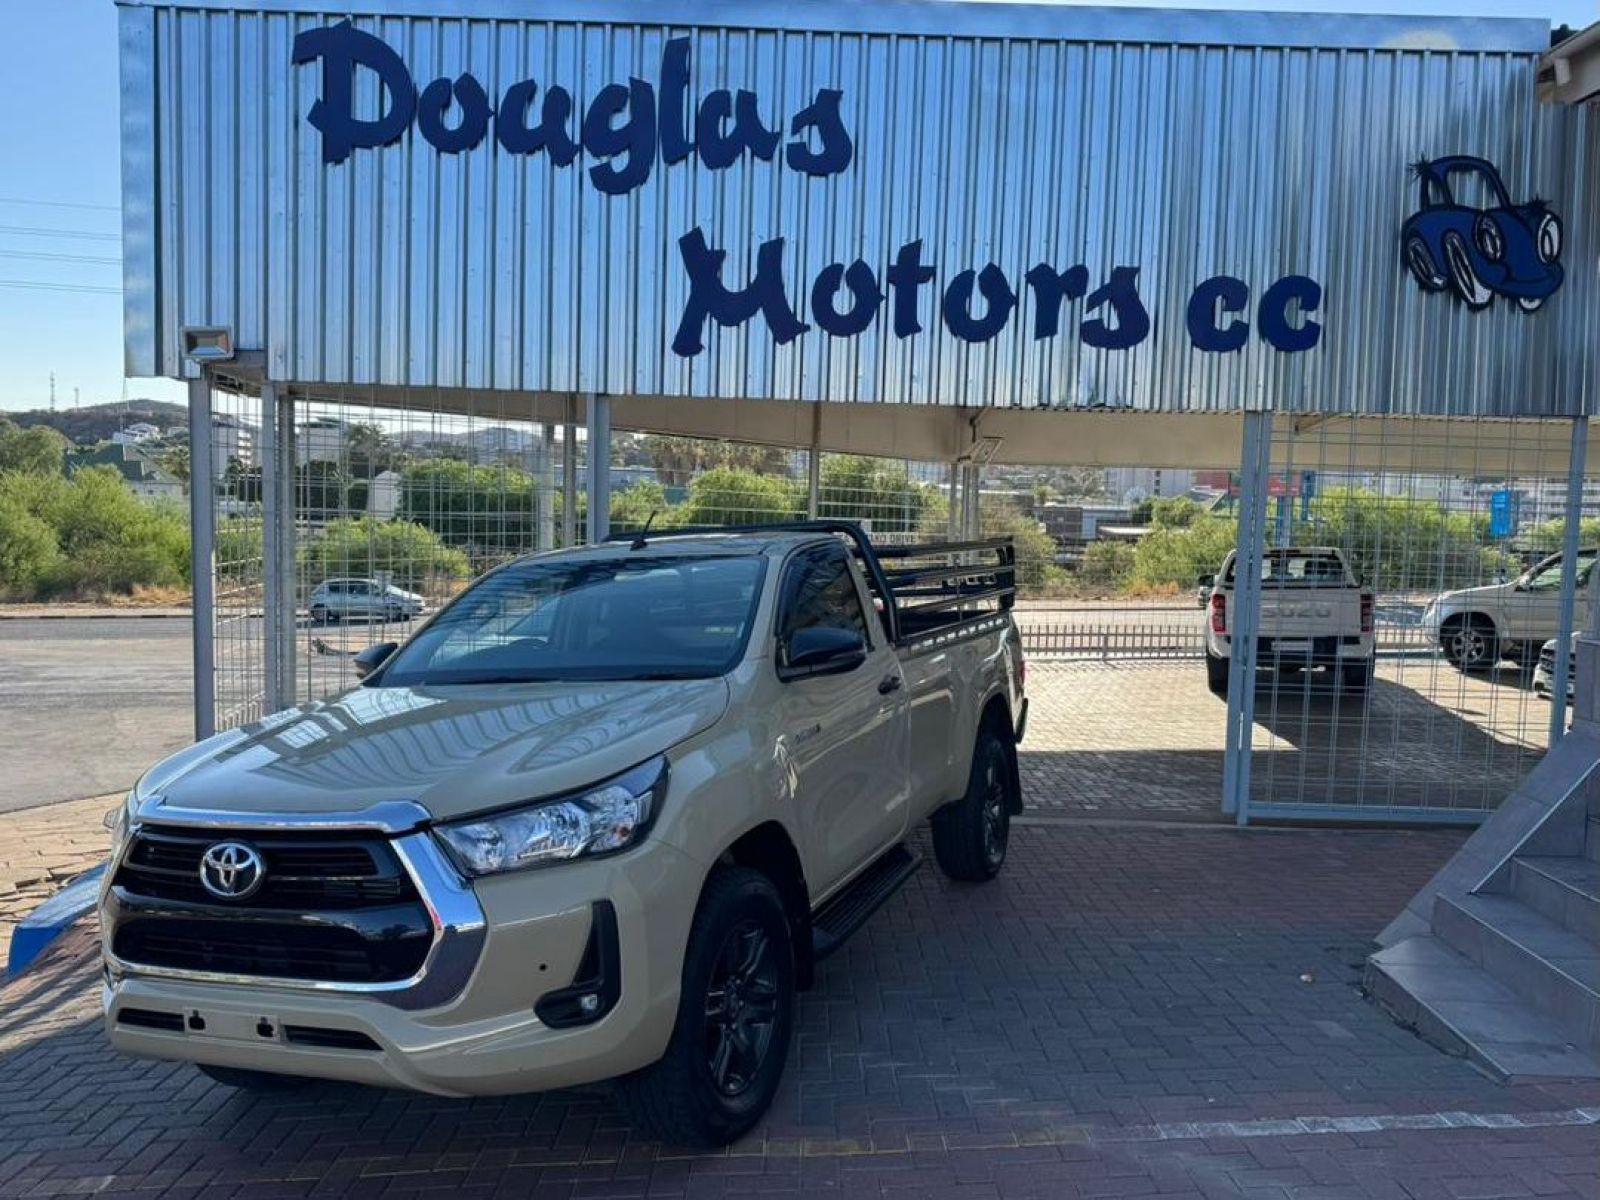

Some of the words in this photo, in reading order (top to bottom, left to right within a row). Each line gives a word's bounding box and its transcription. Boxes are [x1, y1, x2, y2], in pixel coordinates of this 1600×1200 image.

[292, 17, 854, 195] Douglas
[671, 227, 1151, 358] Motors
[1262, 603, 1331, 618] SUZU
